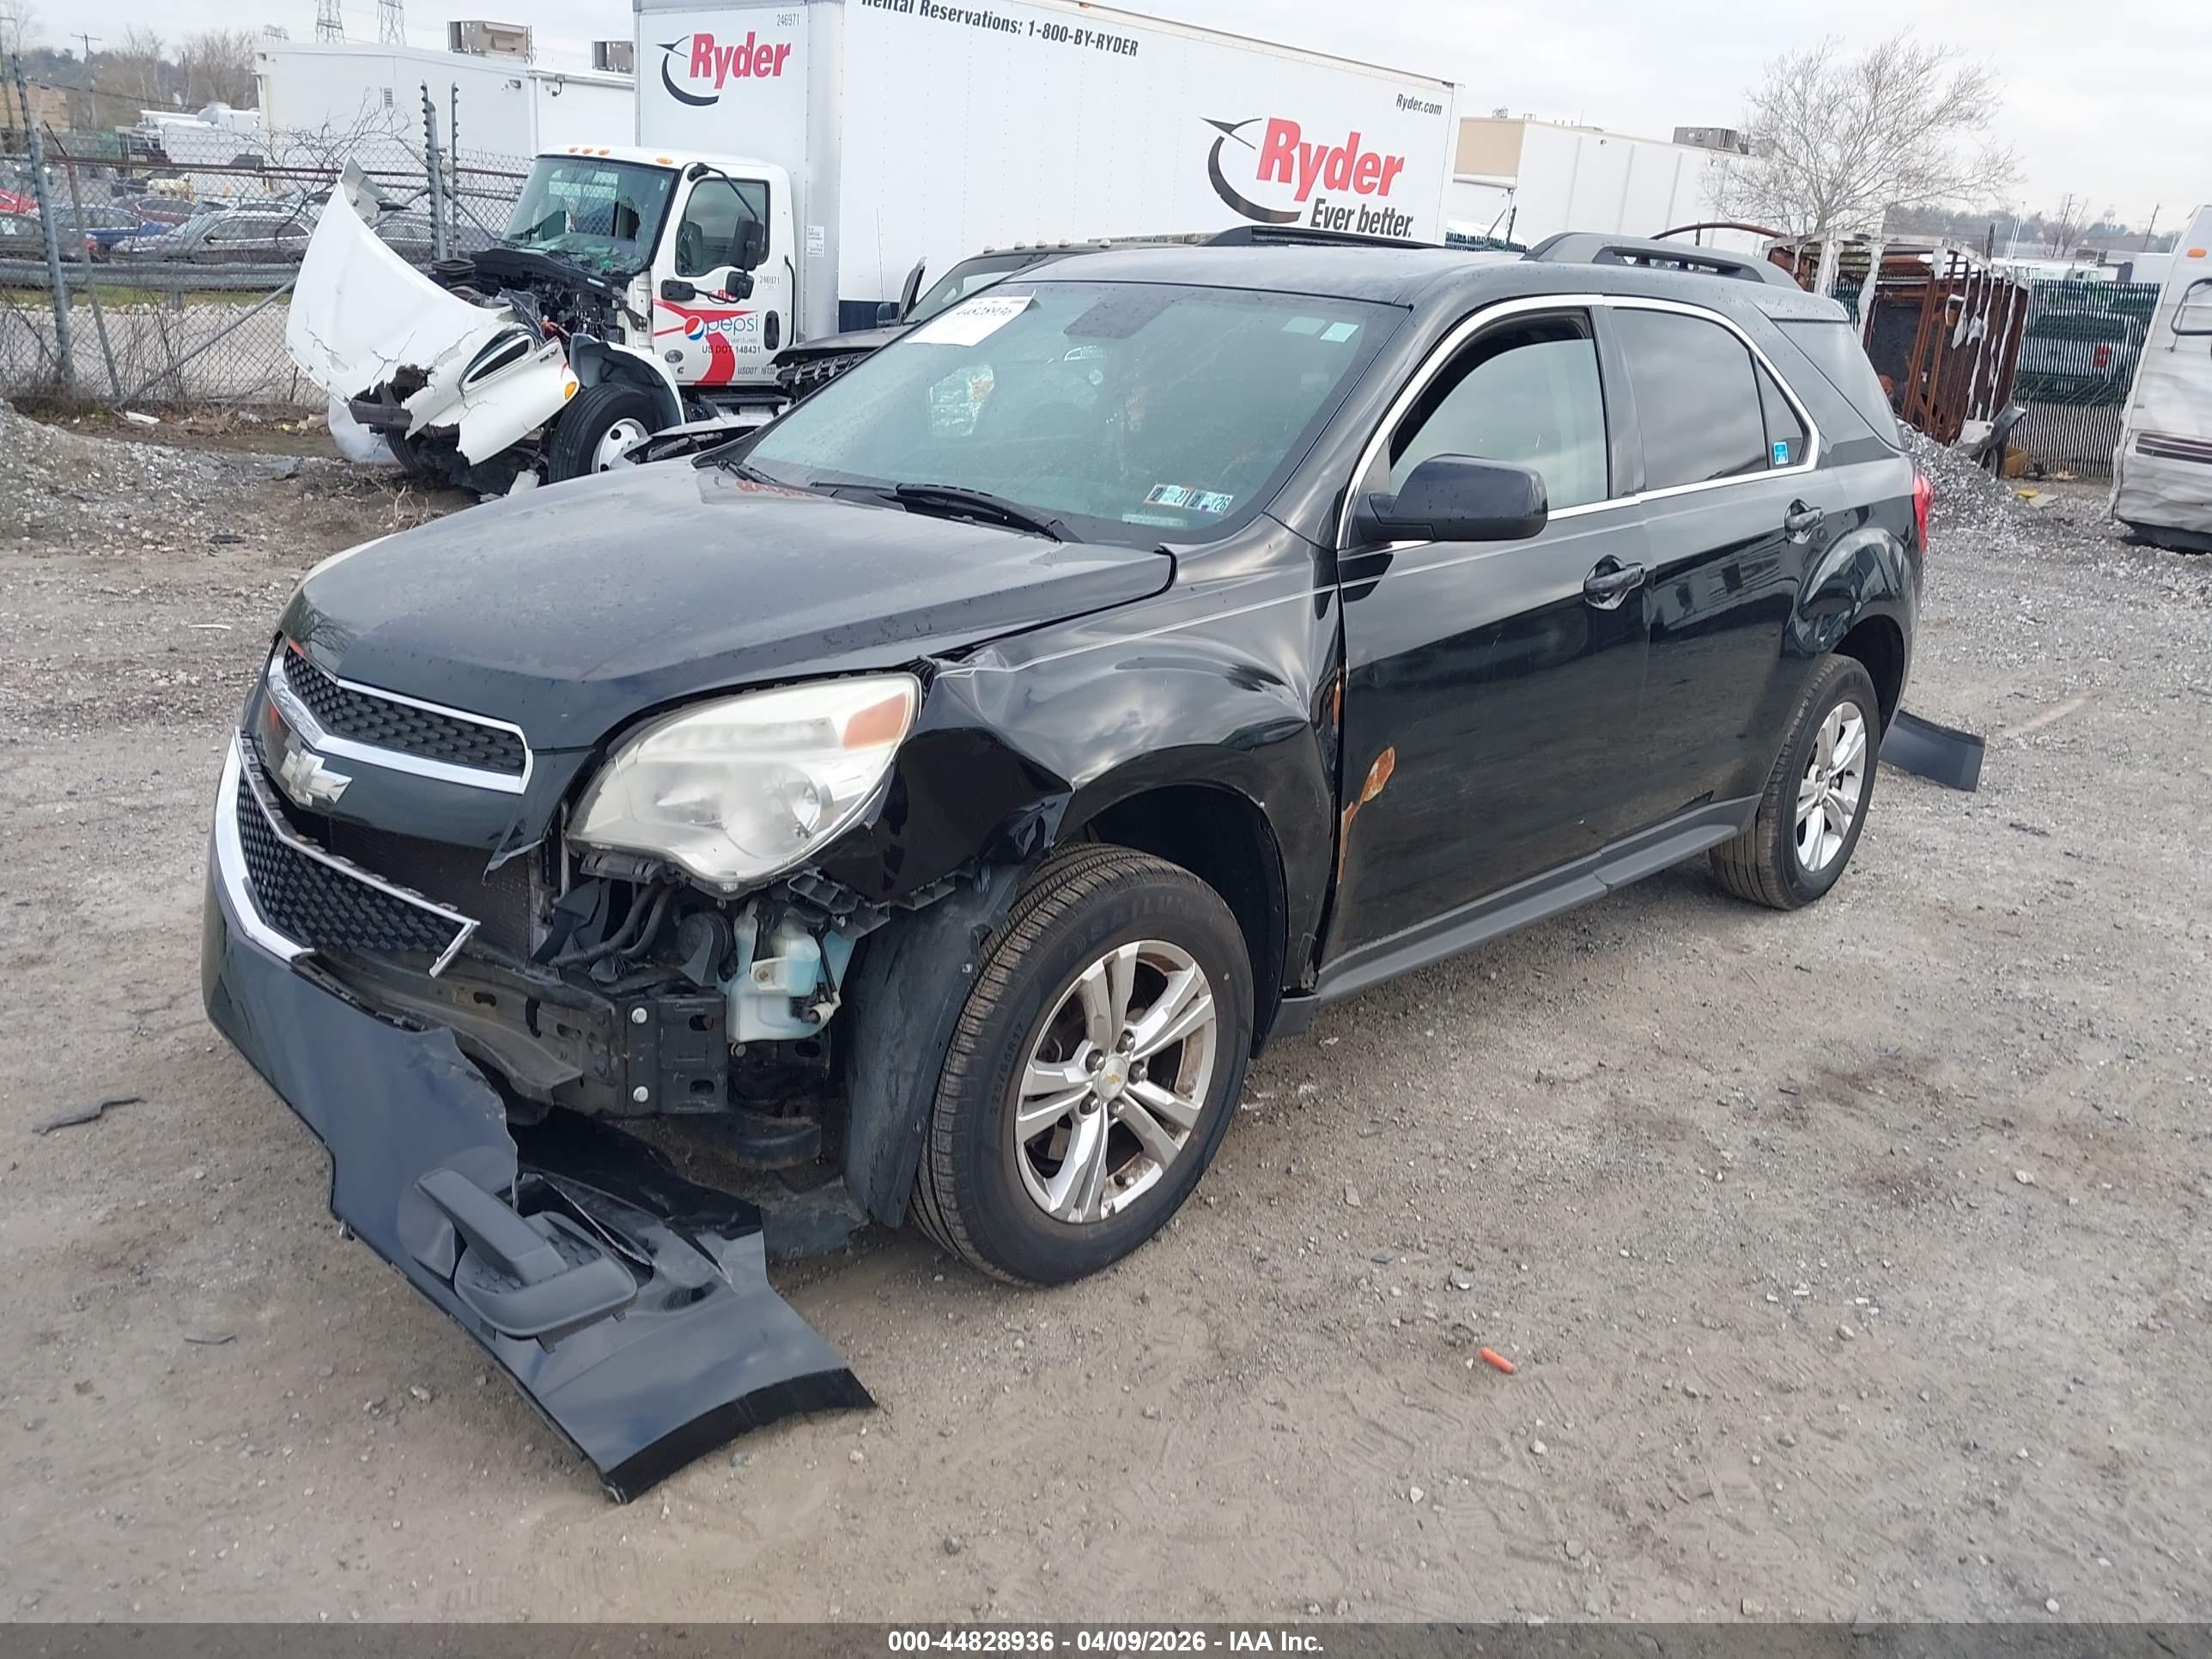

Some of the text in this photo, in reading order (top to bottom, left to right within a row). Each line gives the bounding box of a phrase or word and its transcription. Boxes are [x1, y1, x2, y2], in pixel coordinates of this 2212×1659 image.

[776, 13, 799, 27] 246971
[919, 0, 1024, 35] Reservations:
[1028, 20, 1139, 58] 1-800-BY-RYDER
[689, 31, 792, 90] Ryder
[1395, 94, 1443, 116] Ryder.com
[1256, 117, 1405, 203] Ryder
[1310, 198, 1413, 239] Ever better.
[706, 313, 758, 336] pepsi
[702, 345, 714, 354] US
[735, 345, 761, 354] 148431
